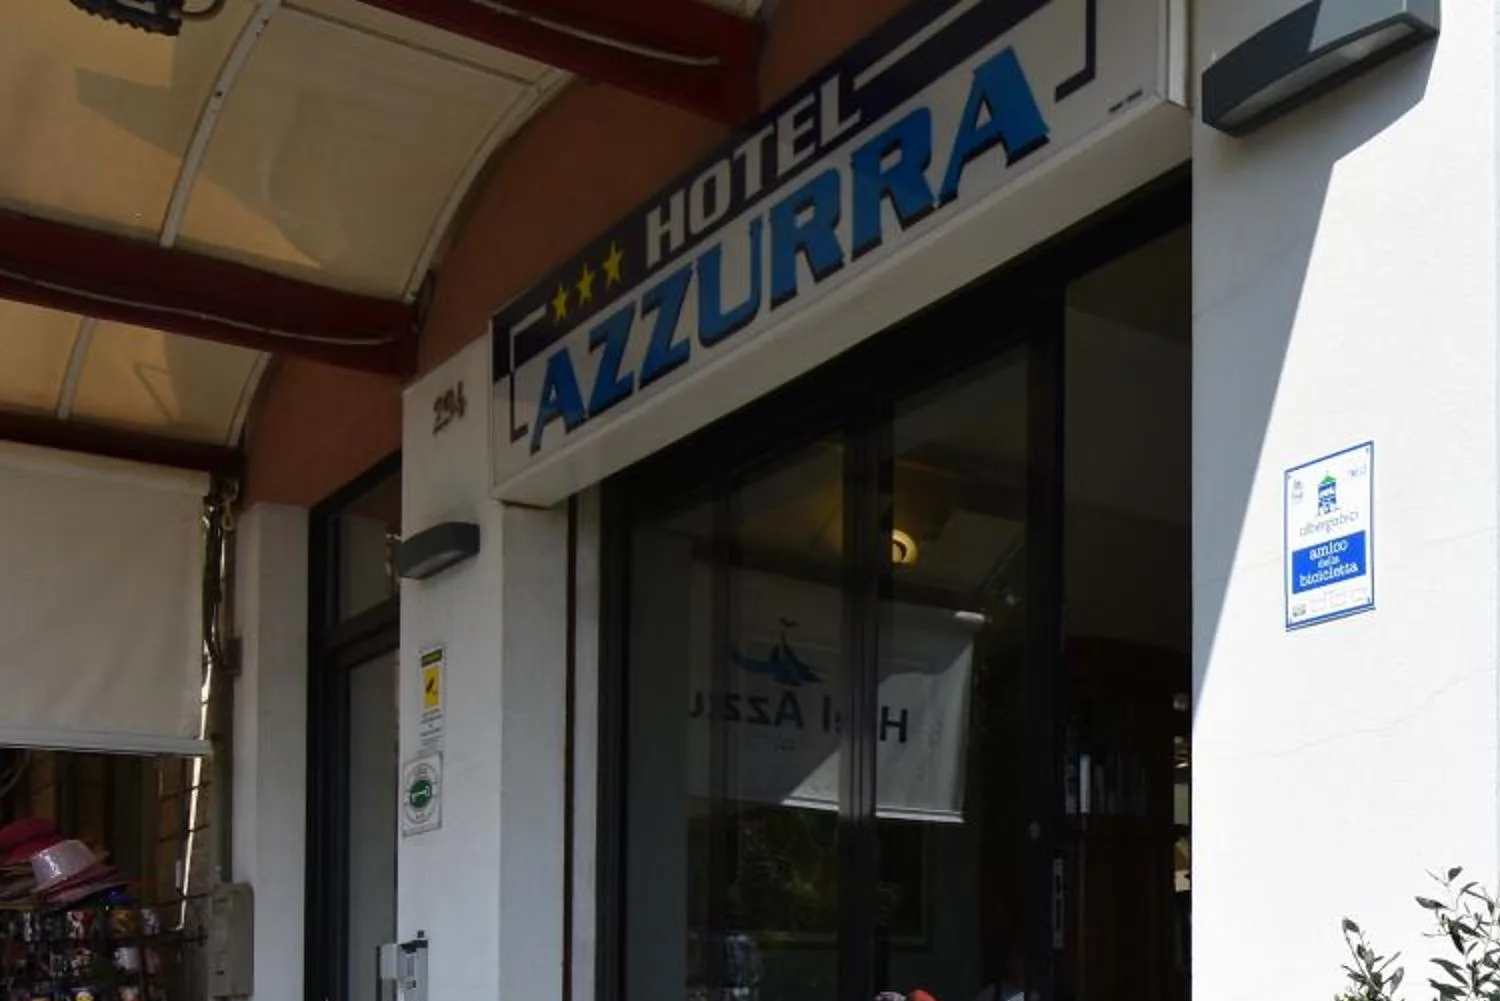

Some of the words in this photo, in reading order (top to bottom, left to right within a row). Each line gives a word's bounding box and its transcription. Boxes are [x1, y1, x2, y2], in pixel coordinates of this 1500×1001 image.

[646, 74, 861, 269] HOTEL
[530, 46, 1049, 456] AZZURRA
[1299, 562, 1359, 587] bicicletta
[1309, 539, 1349, 561] amico
